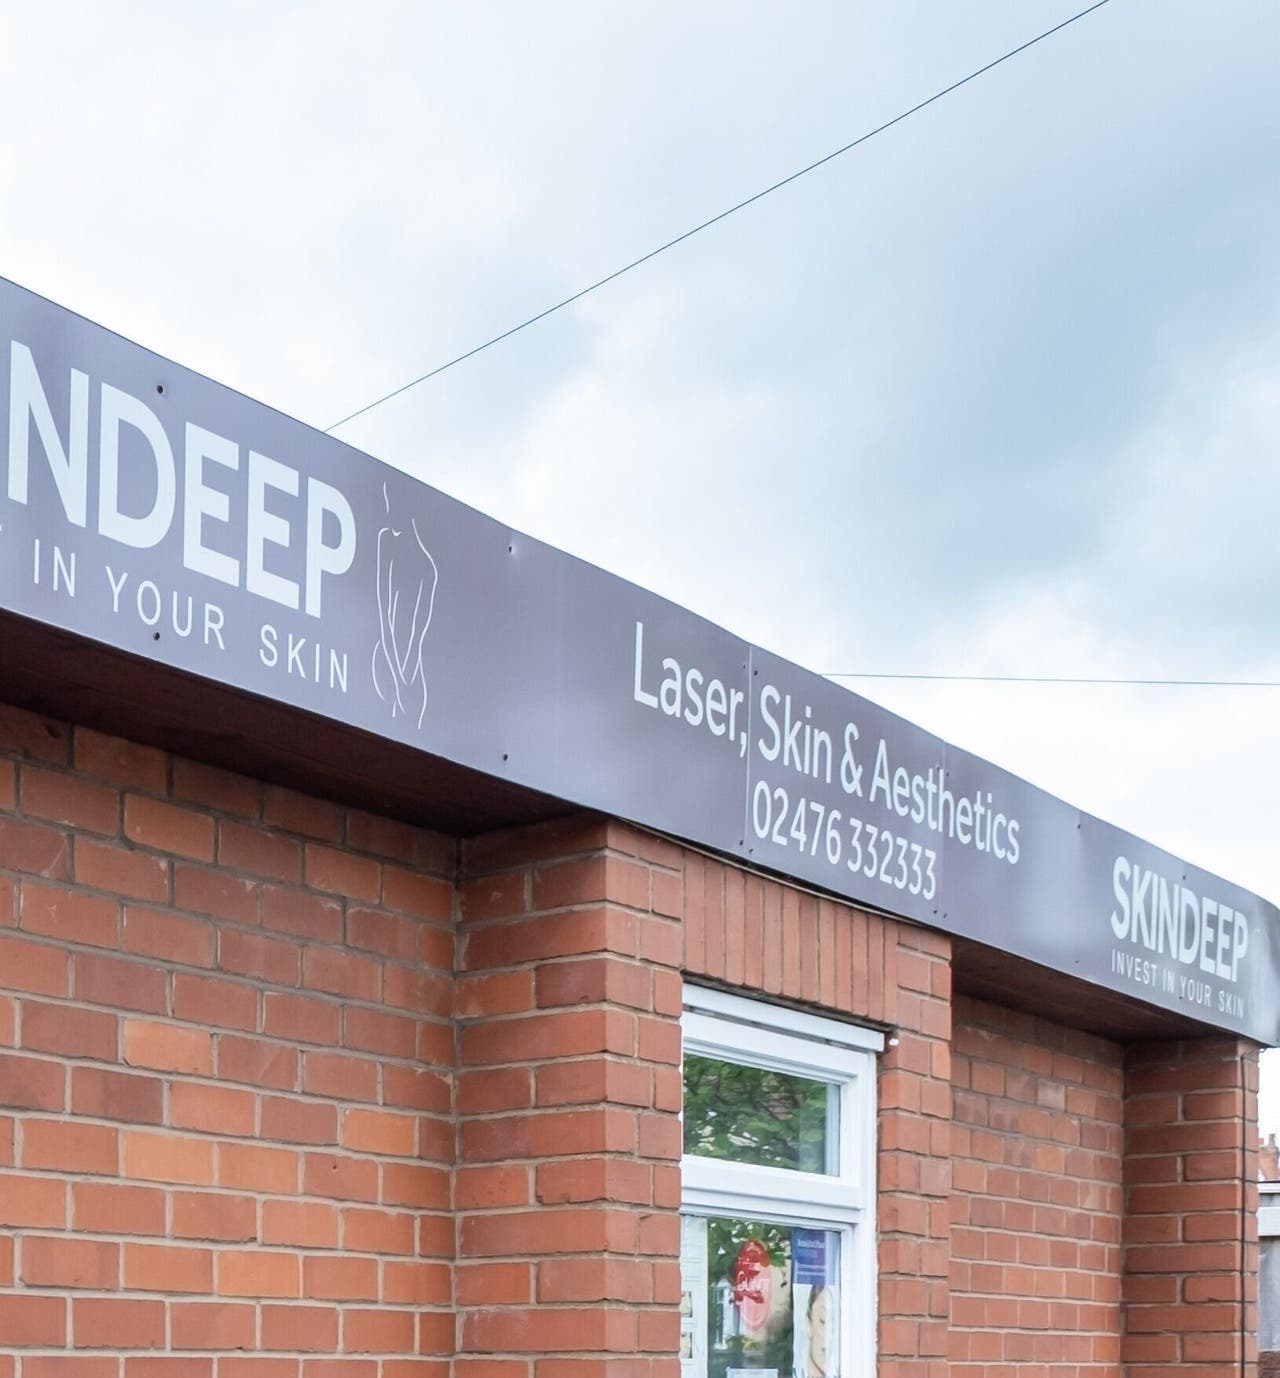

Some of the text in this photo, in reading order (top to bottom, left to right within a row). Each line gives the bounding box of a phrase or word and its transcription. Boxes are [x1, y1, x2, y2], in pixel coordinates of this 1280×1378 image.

[33, 538, 77, 598] IN
[106, 565, 226, 650] YOUR
[258, 622, 349, 693] SKIN
[633, 620, 1020, 865] Laser, Skin & Aesthetics
[752, 779, 937, 901] 02476 332333
[1111, 856, 1248, 982] SKINDEEP
[1112, 949, 1244, 1018] INVEST IN YOUR SKIN
